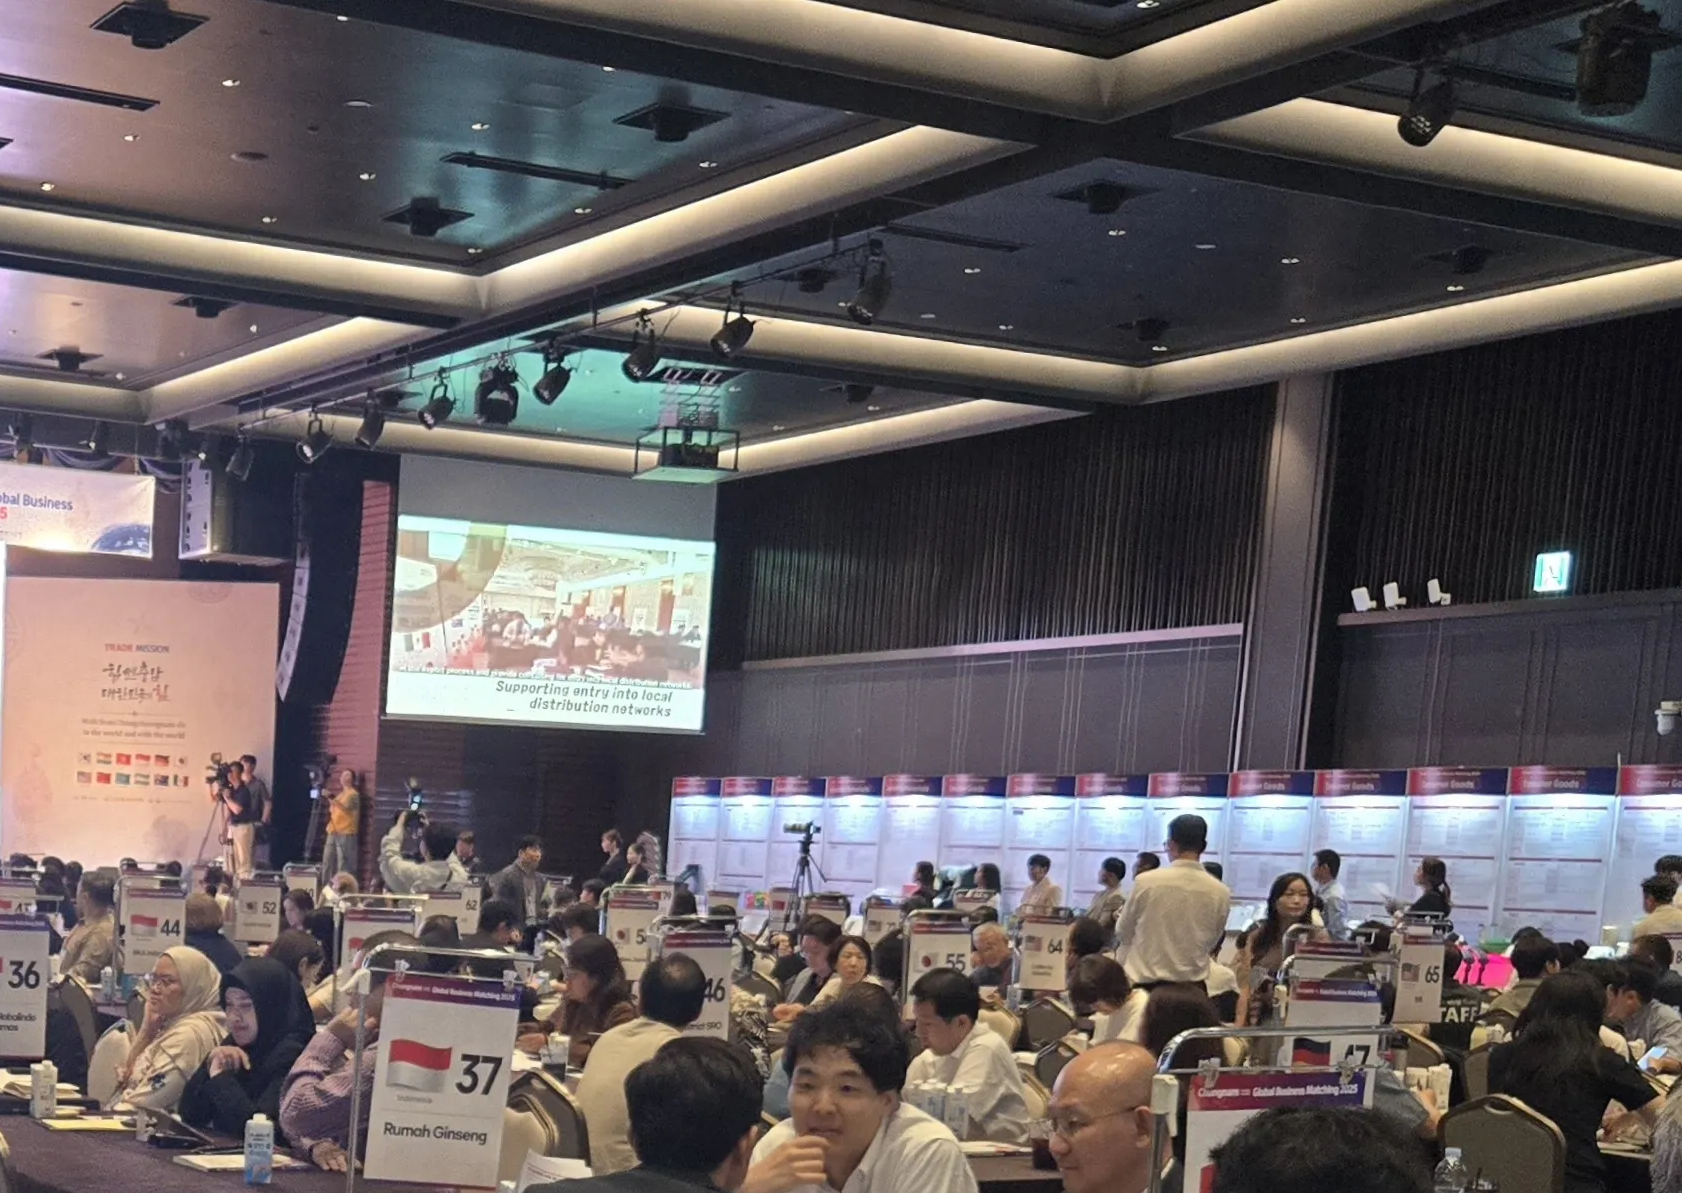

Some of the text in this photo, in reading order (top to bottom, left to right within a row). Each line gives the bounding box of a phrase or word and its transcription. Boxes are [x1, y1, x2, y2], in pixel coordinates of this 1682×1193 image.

[22, 494, 74, 511] Business
[496, 680, 673, 703] Supporting entry into local
[529, 697, 671, 717] distribution networks
[466, 900, 477, 911] 62
[160, 919, 181, 936] 44
[1048, 938, 1063, 954] 64
[946, 953, 966, 973] 55
[7, 960, 40, 989] 36
[1425, 965, 1440, 983] 65
[1440, 1007, 1479, 1023] TAFF
[455, 1054, 503, 1096] 37
[1198, 1088, 1239, 1099] Chungnam
[1253, 1086, 1275, 1097] Global
[1276, 1086, 1305, 1096] Business
[1306, 1084, 1339, 1096] Matching
[383, 1121, 487, 1145] Rumah Ginseng
